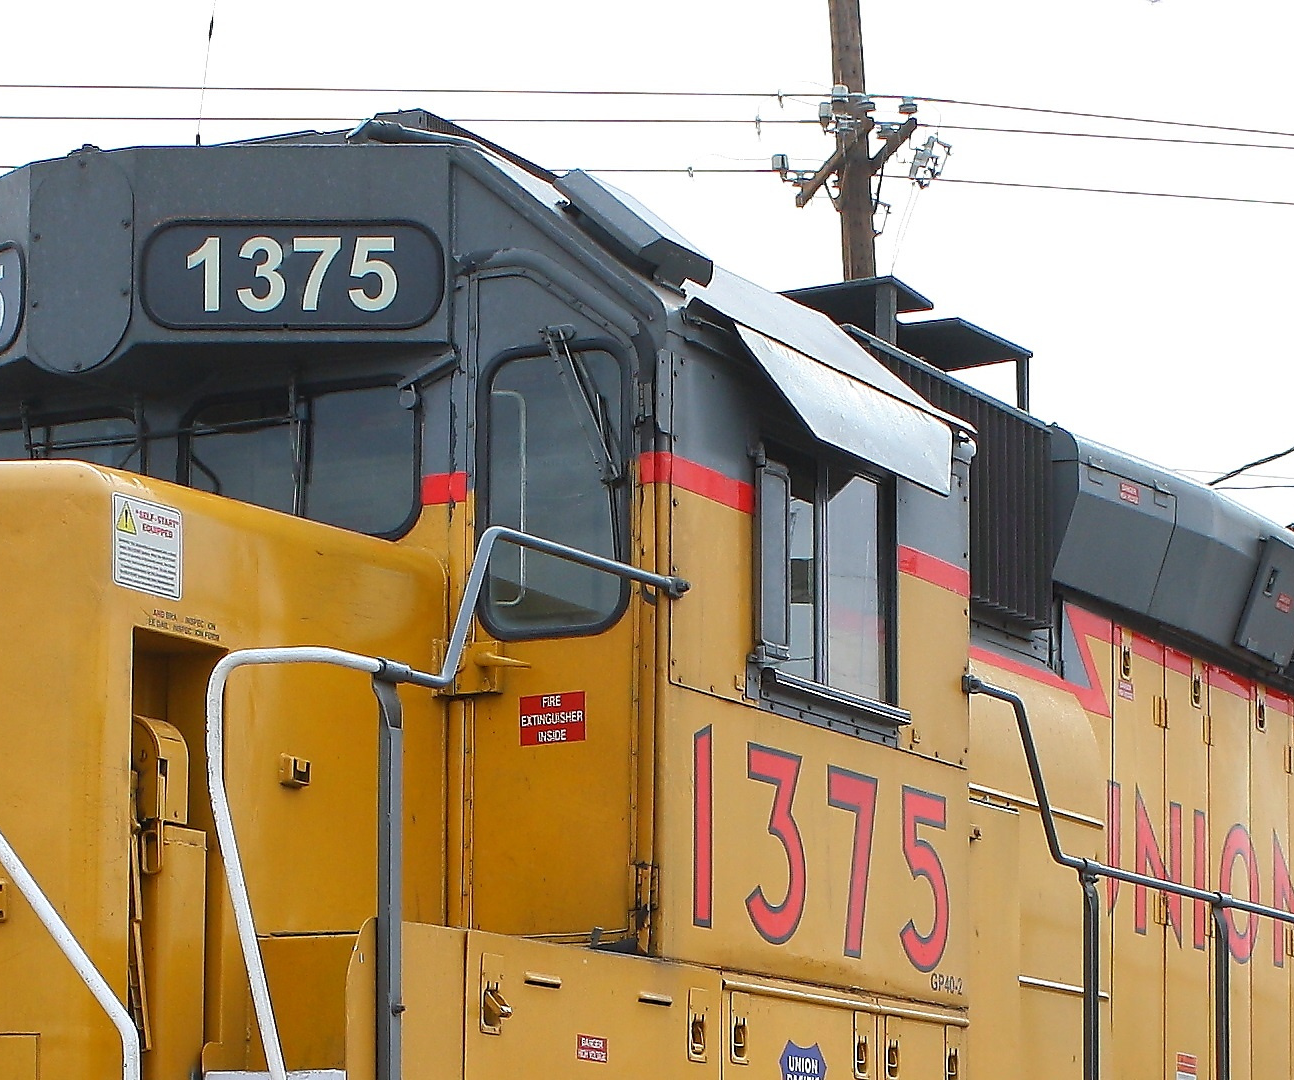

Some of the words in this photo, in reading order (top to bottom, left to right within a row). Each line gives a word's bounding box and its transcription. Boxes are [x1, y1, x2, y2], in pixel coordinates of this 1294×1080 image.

[187, 235, 399, 313] 1375
[542, 695, 562, 708] FIRE
[521, 710, 583, 727] EXTINGUISHER
[538, 729, 567, 742] INSIDE
[693, 724, 950, 973] 1375
[930, 972, 963, 995] GP40-2
[788, 1055, 818, 1074] UNION
